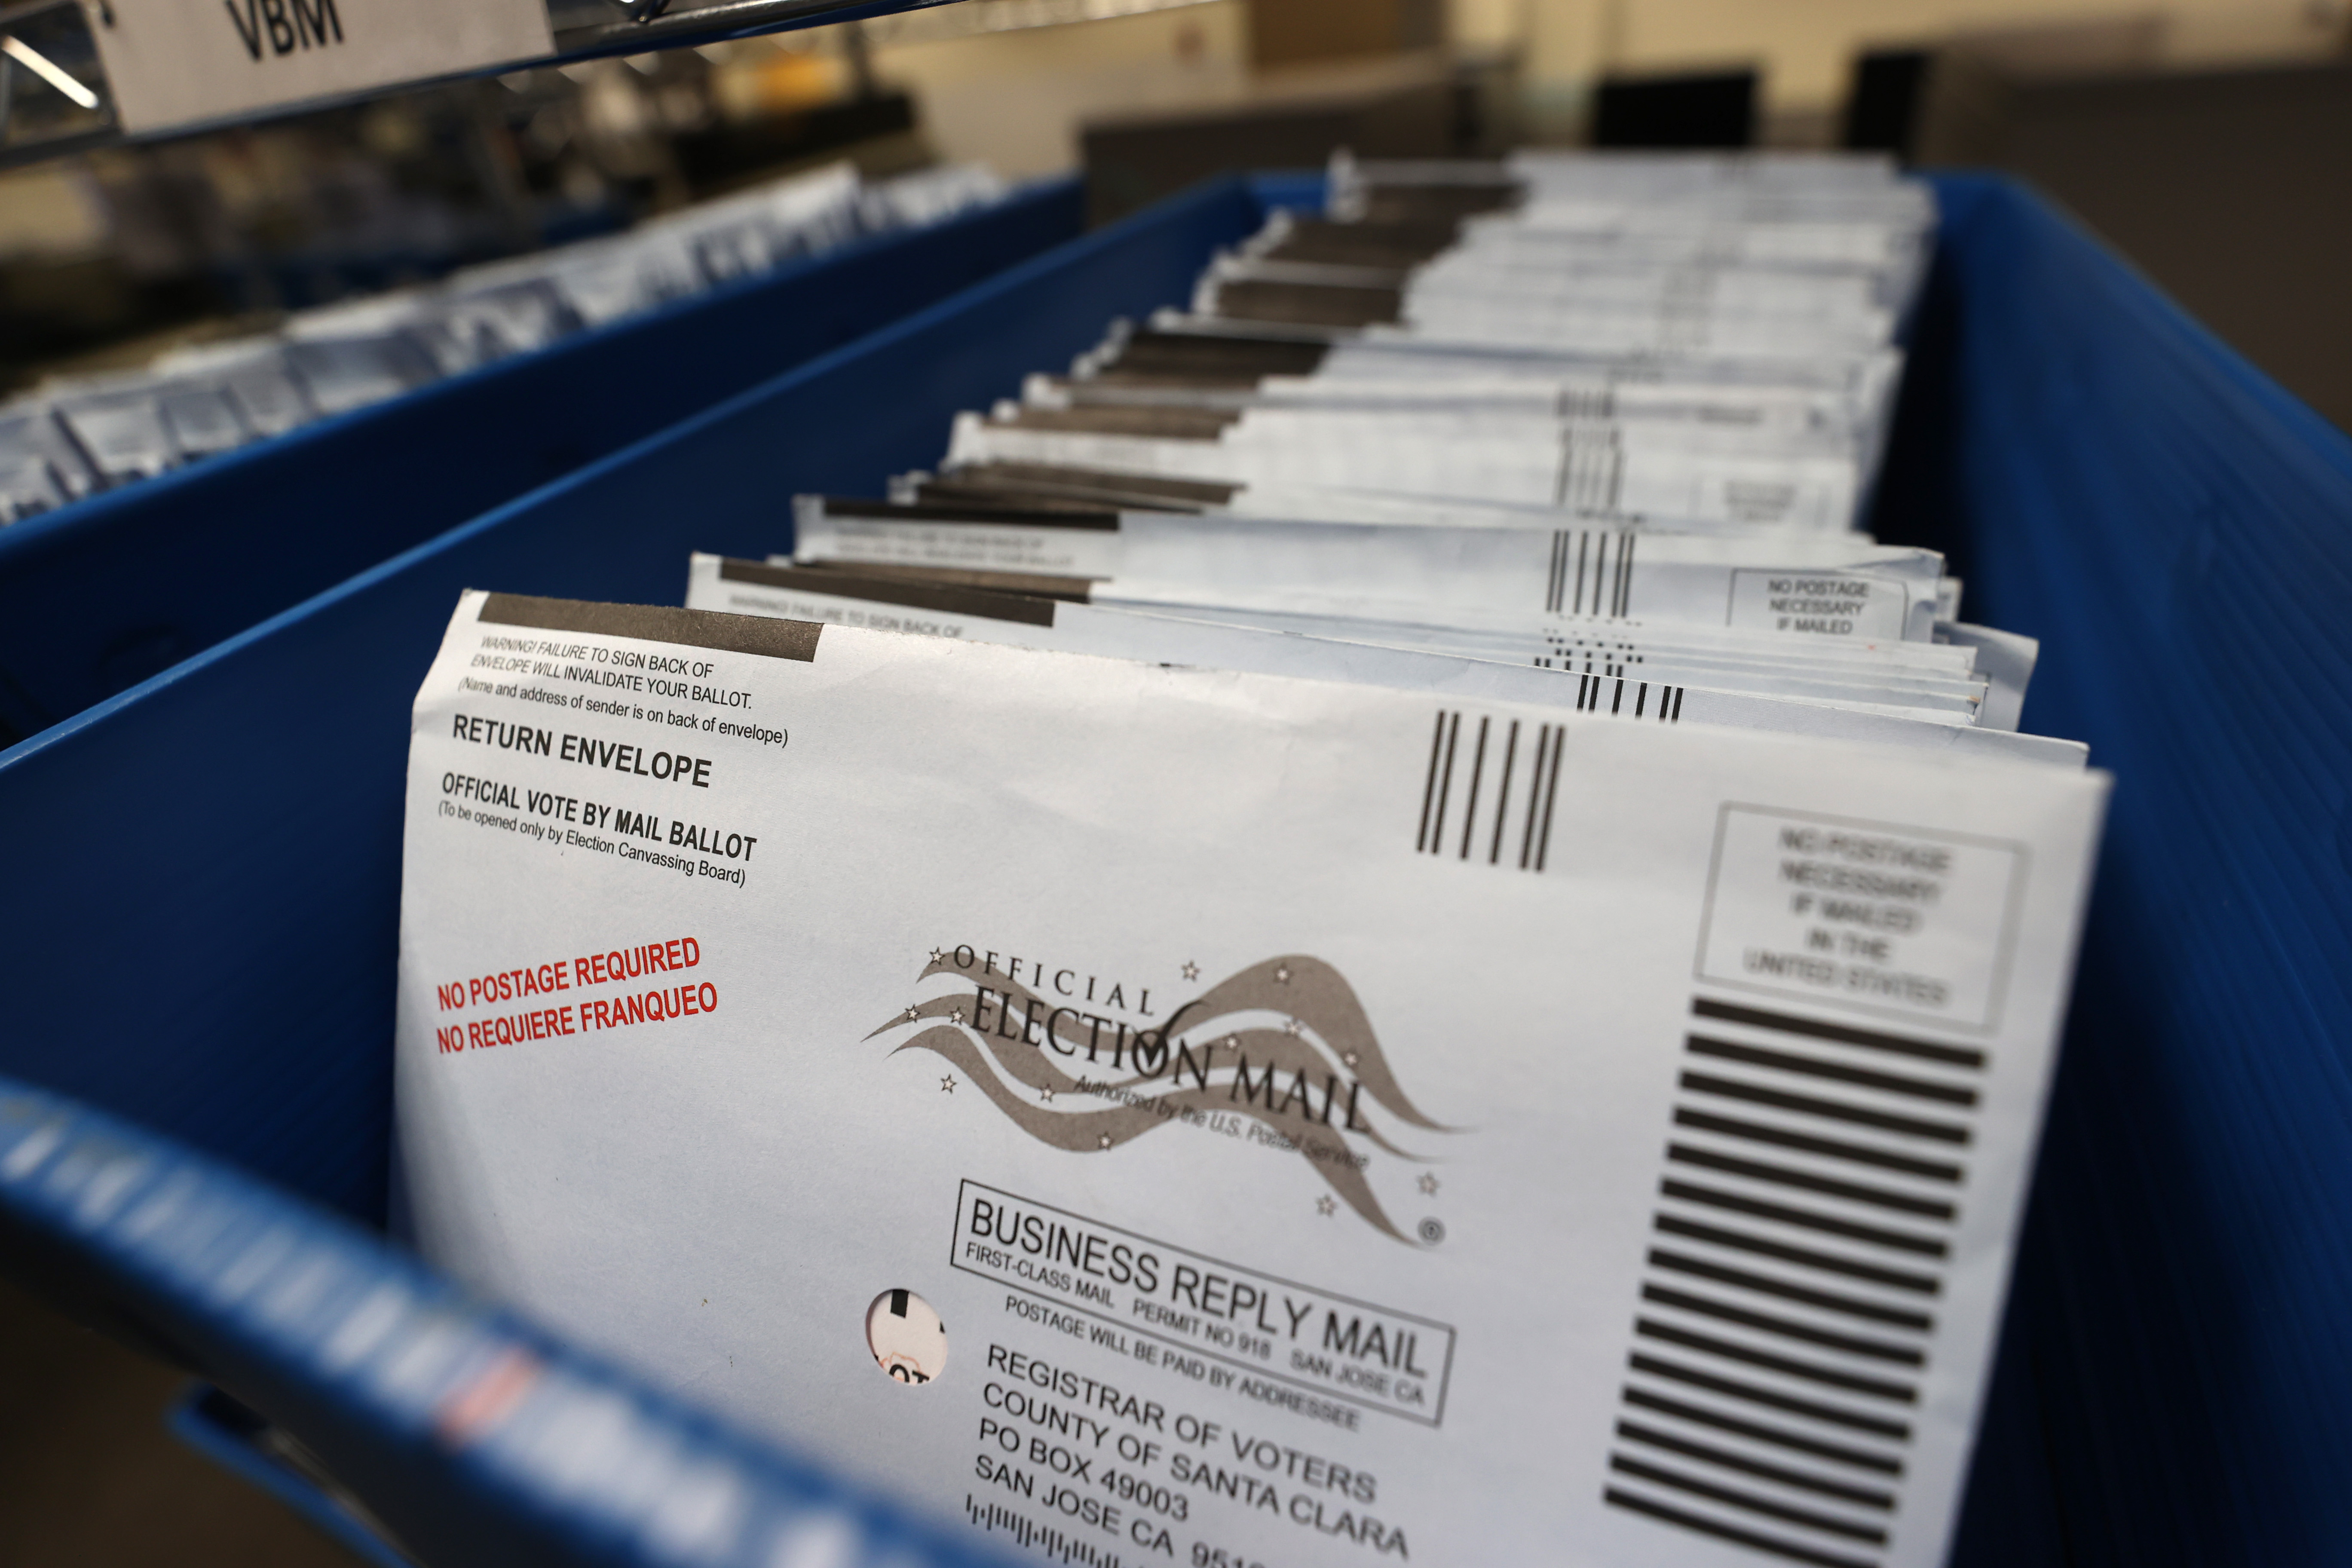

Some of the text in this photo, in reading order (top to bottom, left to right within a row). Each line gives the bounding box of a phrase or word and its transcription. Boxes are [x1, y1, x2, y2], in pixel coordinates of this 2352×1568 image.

[224, 0, 345, 61] VBM
[1768, 579, 1870, 597] NO POSTAGE
[1768, 598, 1864, 616] NECESSARY
[537, 641, 589, 660] FAILURE
[591, 647, 609, 662] TO
[611, 650, 646, 668] SIGN
[649, 655, 689, 675] BACK
[692, 662, 714, 678] OF
[903, 618, 940, 635] BACK
[1793, 618, 1853, 634] MAILED
[457, 675, 788, 749] (Name and address of sender is on back of envelope)
[471, 653, 752, 709] ENVELOPE WILL INVALIDATE YOUR BALLOT.
[453, 713, 713, 788] RETURN ENVELOPE
[438, 799, 746, 889] (To be opened only by Election Canvassing Board)
[442, 772, 758, 861] OFFICIAL VOTE BY MAIL BALLOT
[438, 937, 699, 1011] NO POSTAGE REQUIRED
[953, 944, 1154, 1016] OFFICIAL
[437, 982, 717, 1054] NO REQUIERE FRANQUEO
[971, 984, 1370, 1135] ELECTION MAIL
[1075, 1074, 1156, 1114] Authorized
[1158, 1098, 1178, 1118] by
[1209, 1113, 1243, 1140] U.S.
[966, 1242, 1071, 1292] FIRST-CLASS
[1075, 1277, 1115, 1309] MAIL
[1132, 1297, 1202, 1336] PERMIT
[1205, 1323, 1235, 1349] NO
[1289, 1349, 1333, 1376] SAN
[971, 1198, 1428, 1378] BUSINESS REPLY MAIL
[1005, 1294, 1086, 1339] POSTAGE
[1089, 1324, 1129, 1355] WILL
[1133, 1339, 1158, 1366] BE
[1162, 1349, 1205, 1382] PAID
[1208, 1366, 1237, 1391] BY
[987, 1343, 1377, 1504] REGISTRAR OF VOTERS
[975, 1454, 1033, 1499] SAN
[1041, 1483, 1121, 1536] JOSE
[1130, 1518, 1174, 1558] CA
[979, 1417, 1189, 1523] PO BOX 49003
[983, 1382, 1409, 1563] COUNTY OF SANTA CLARA
